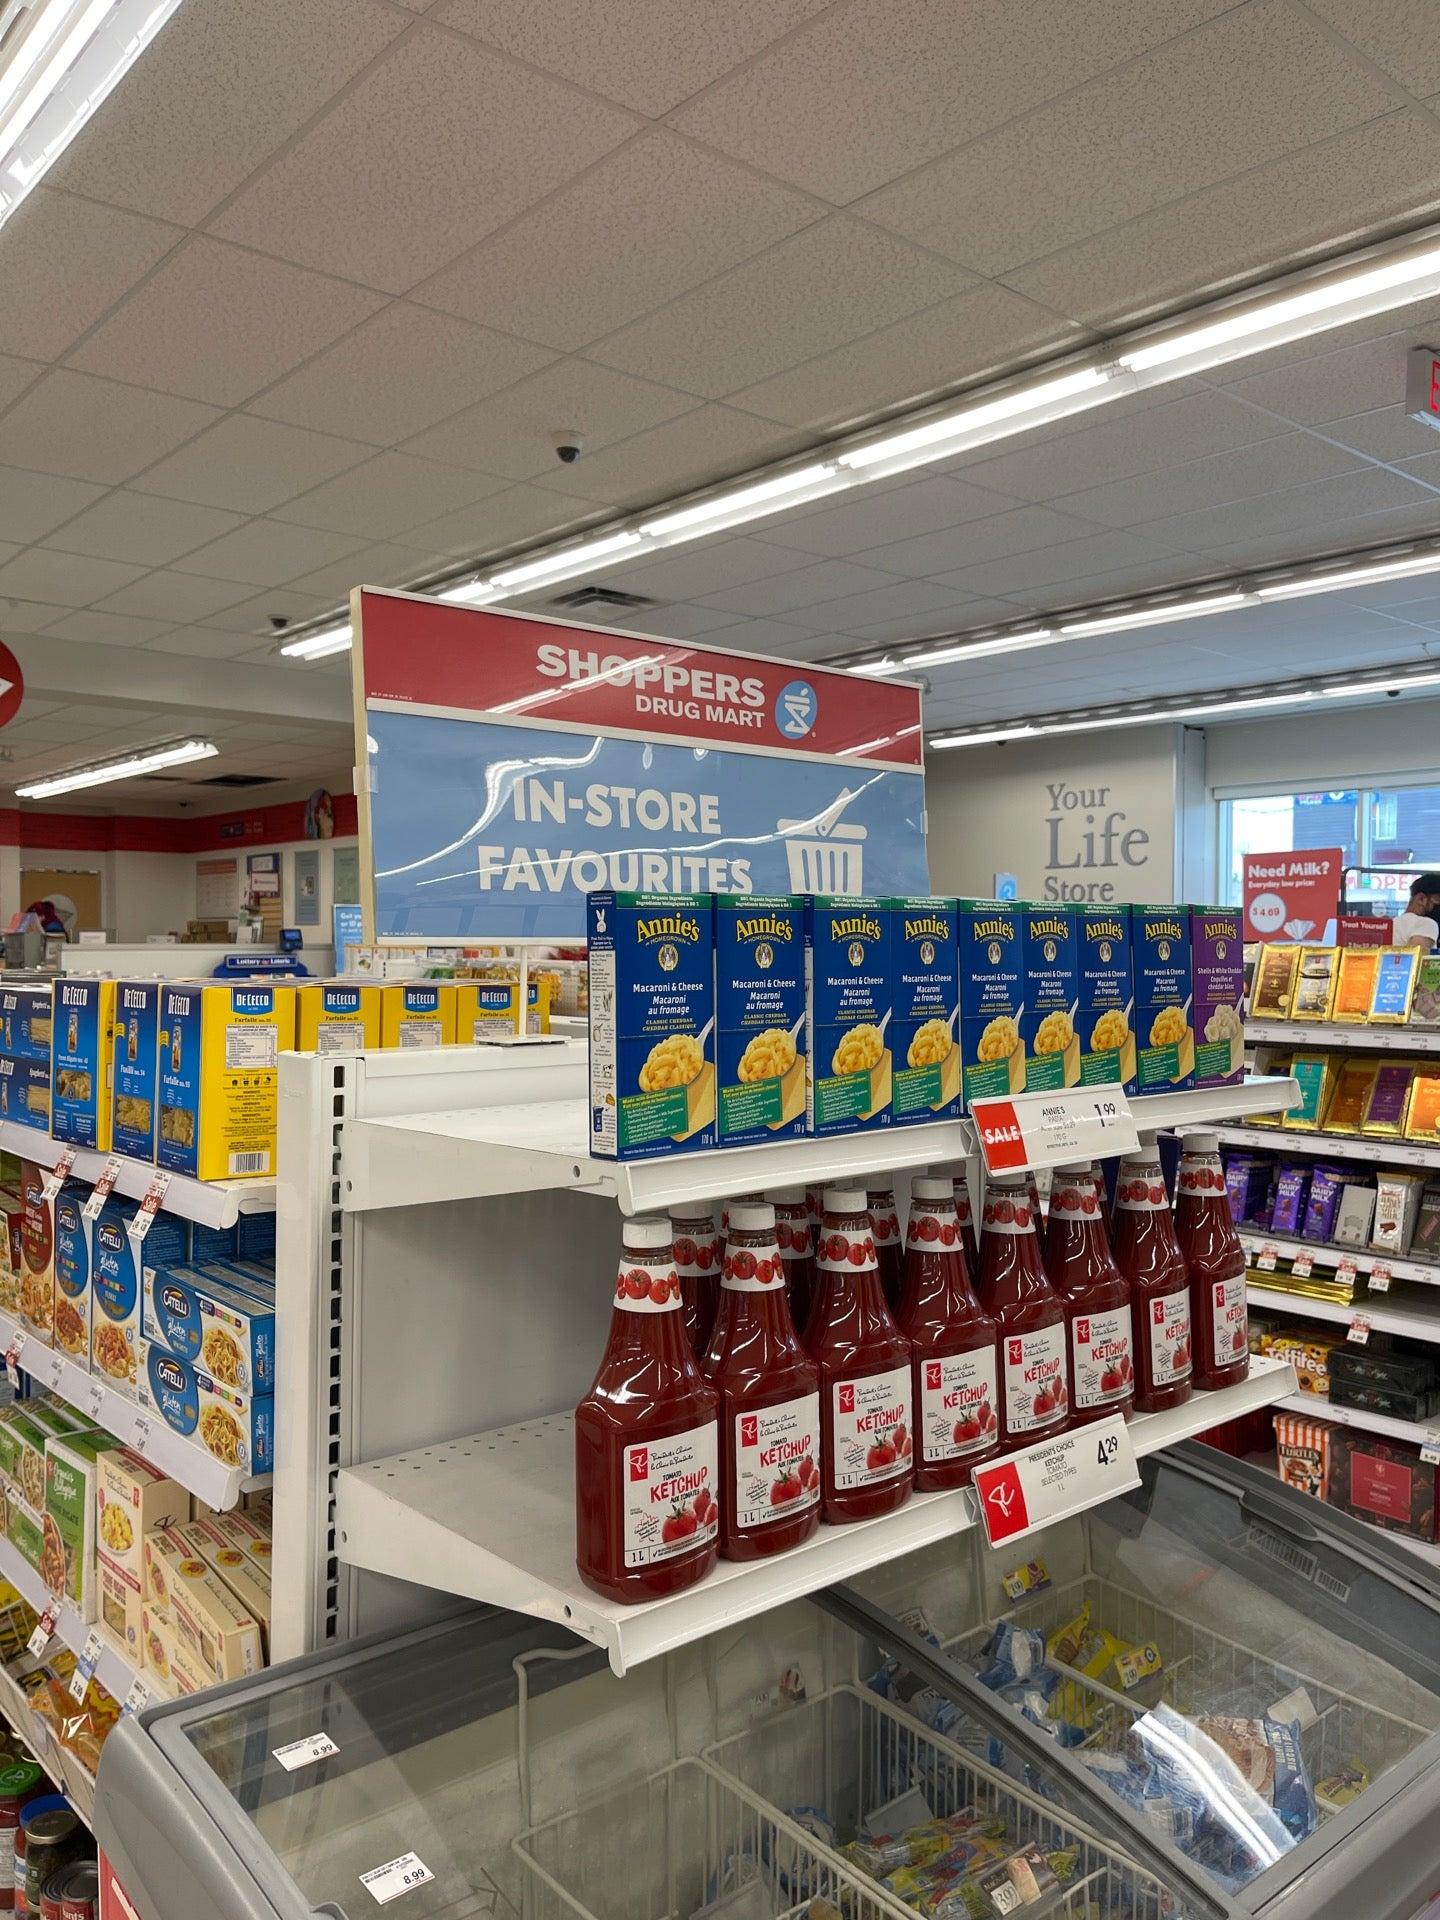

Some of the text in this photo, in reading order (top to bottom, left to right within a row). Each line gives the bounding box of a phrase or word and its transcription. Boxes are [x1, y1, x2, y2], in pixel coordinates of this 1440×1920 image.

[536, 645, 766, 707] SHOPPERS
[635, 694, 765, 728] DRUG MART
[1046, 784, 1110, 811] Your
[513, 778, 722, 834] IN-STORE
[1045, 813, 1149, 869] Life
[478, 846, 753, 893] FAVOURITES
[1248, 862, 1329, 877] Need Milk?
[1044, 876, 1114, 902] Store
[1248, 881, 1279, 889] Everyday
[1295, 880, 1315, 888] price:
[637, 913, 700, 945] Annie's
[736, 914, 793, 943] Annie's
[831, 914, 881, 941] Annie's
[905, 915, 949, 941] Annie's
[974, 917, 1014, 941] Annie's
[1030, 917, 1069, 940] Annie's
[1086, 919, 1124, 941] Annie's
[1145, 919, 1181, 940] Annie's
[1205, 920, 1237, 941] Annie's
[1361, 922, 1388, 930] Yourself
[651, 935, 686, 943] HOMEGROWN
[748, 935, 780, 943] HOMEGROWN
[732, 980, 766, 989] Macaroni
[773, 979, 795, 988] Cheese
[827, 977, 858, 985] Macaroni
[864, 976, 883, 985] Cheese
[1002, 973, 1017, 981] Cheese
[633, 982, 703, 992] Macaroni & Cheese
[652, 996, 686, 1004] Macaroni
[750, 991, 780, 1000] Macaroni
[848, 997, 873, 1006] fromage
[921, 994, 943, 1003] fromage
[648, 1005, 689, 1015] au fromage
[746, 1001, 783, 1010] au fromage
[120, 1064, 134, 1075] Fusilli
[1042, 1106, 1066, 1116] ANNIE'S
[985, 1125, 1020, 1145] SALE
[1226, 1173, 1248, 1181] DAIRY
[1279, 1182, 1301, 1191] DAIRY
[1279, 1189, 1296, 1197] MILK
[1311, 1186, 1334, 1196] DAIRY
[1311, 1193, 1329, 1202] MILK
[59, 1210, 75, 1229] CATELLI
[98, 1228, 121, 1249] CATELLI
[163, 1289, 188, 1314] CATELLI
[1091, 1337, 1127, 1361] KETCHUP
[1265, 1347, 1327, 1376] Toffifee
[158, 1363, 183, 1387] CATELLI
[1024, 1357, 1060, 1383] KETCHUP
[943, 1382, 988, 1410] KETCHUP
[857, 1404, 904, 1433] KETCHUP
[770, 1437, 787, 1447] TOMATO
[760, 1434, 811, 1468] KETCHUP
[1029, 1440, 1075, 1463] PRESIDENT'S CHOICE
[1045, 1454, 1065, 1467] KETCHUP
[663, 1470, 682, 1481] TOMATO
[1046, 1462, 1067, 1475] TOMATO
[650, 1466, 708, 1503] KETCHUP
[842, 1474, 852, 1485] 1 L
[1041, 1467, 1077, 1487] SELECTED TYPES
[670, 1489, 700, 1504] AUX TOMATES
[744, 1511, 755, 1523] 1 L
[632, 1550, 644, 1563] 1 L
[312, 1743, 333, 1756] 8.99
[403, 1868, 425, 1884] 8.99
